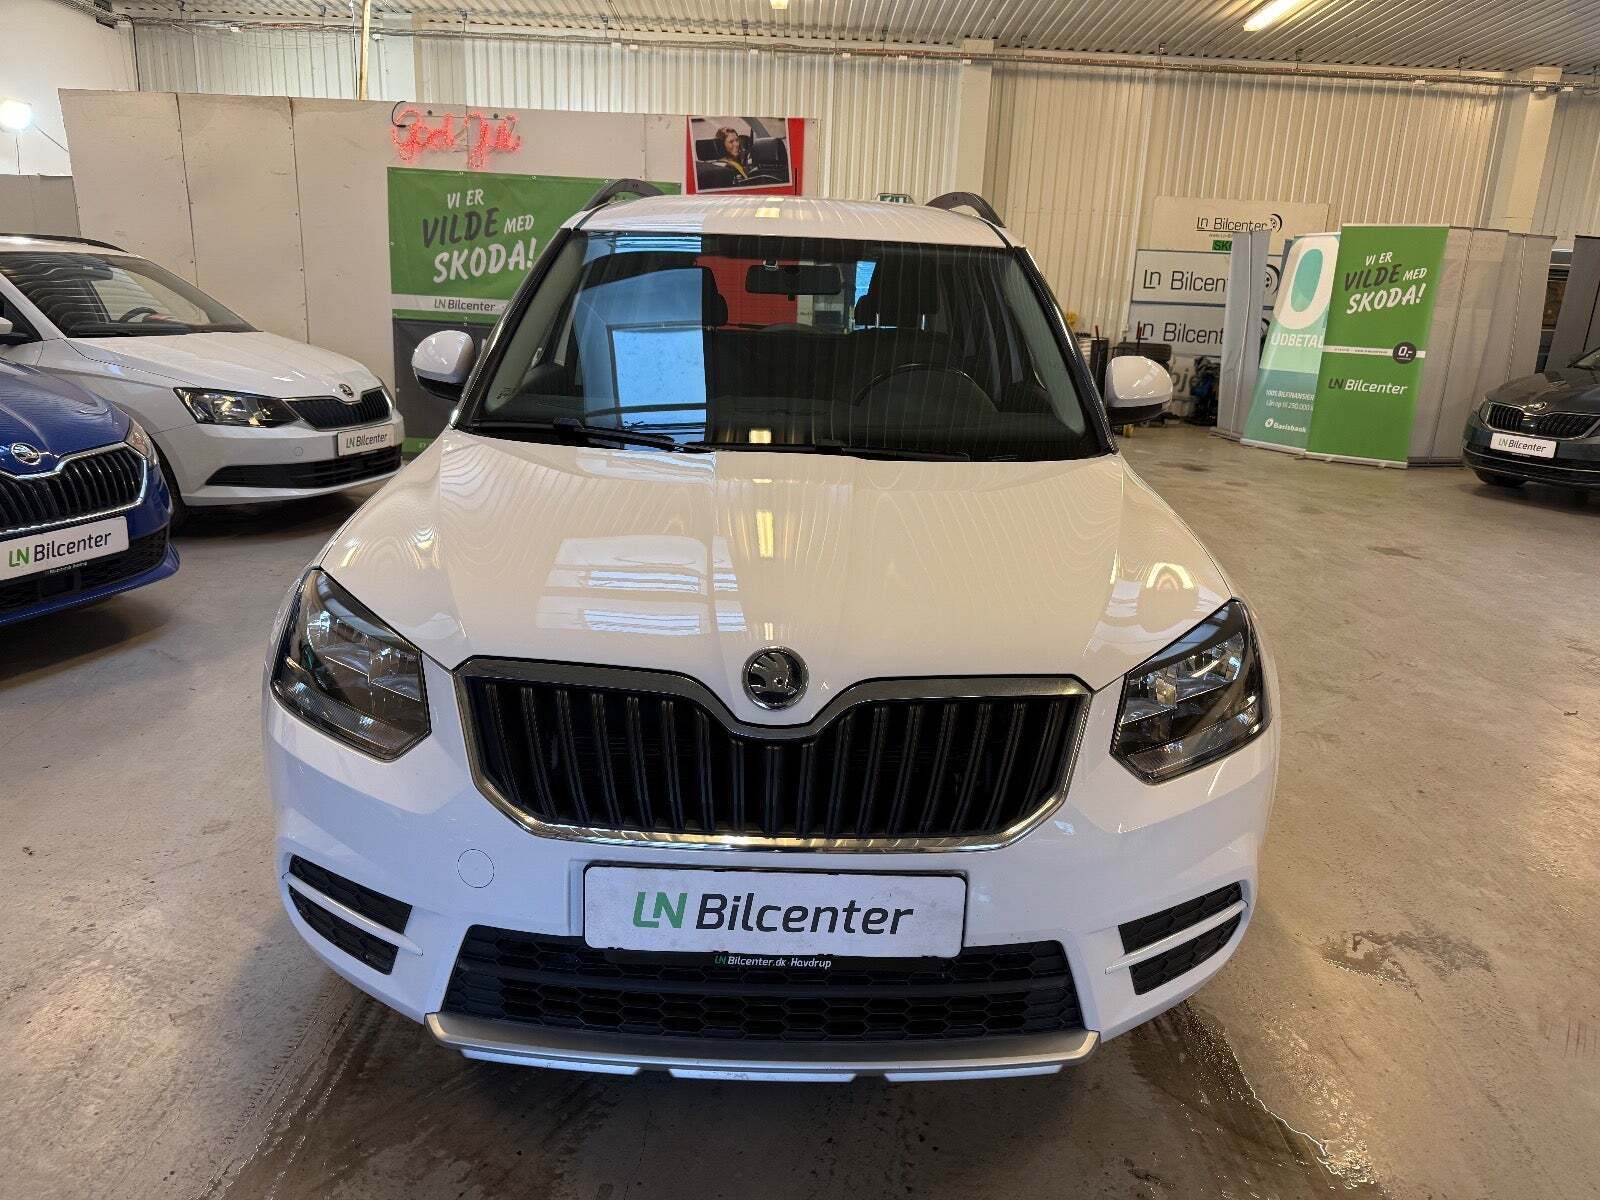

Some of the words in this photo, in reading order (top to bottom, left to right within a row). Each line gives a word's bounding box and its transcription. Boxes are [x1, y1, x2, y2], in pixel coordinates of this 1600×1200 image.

[447, 193, 460, 209] VI
[466, 188, 484, 206] ER
[422, 207, 500, 249] VILDE
[503, 214, 535, 235] MED
[1213, 217, 1268, 232] Bilcenter
[433, 237, 537, 284] SKODA!
[1365, 254, 1376, 266] VI
[1379, 251, 1393, 264] ER
[1170, 270, 1228, 292] Bilcen
[1344, 263, 1402, 291] VILDE
[1402, 267, 1428, 281] MED
[434, 299, 447, 310] LN
[447, 299, 496, 312] Bilcenter
[1346, 283, 1427, 315] SKODA!
[1328, 378, 1344, 390] LN
[1344, 378, 1408, 395] Bilcenter
[346, 437, 356, 448] LN
[356, 433, 388, 447] Bilcenter
[1508, 439, 1547, 453] Bilcenter
[8, 546, 30, 568] LN
[33, 532, 112, 563] Bilcenter
[632, 891, 688, 929] LN
[696, 892, 914, 935] Bilcenter
[727, 956, 786, 967] Bilcenter.dk
[791, 957, 832, 970] Havdrup
